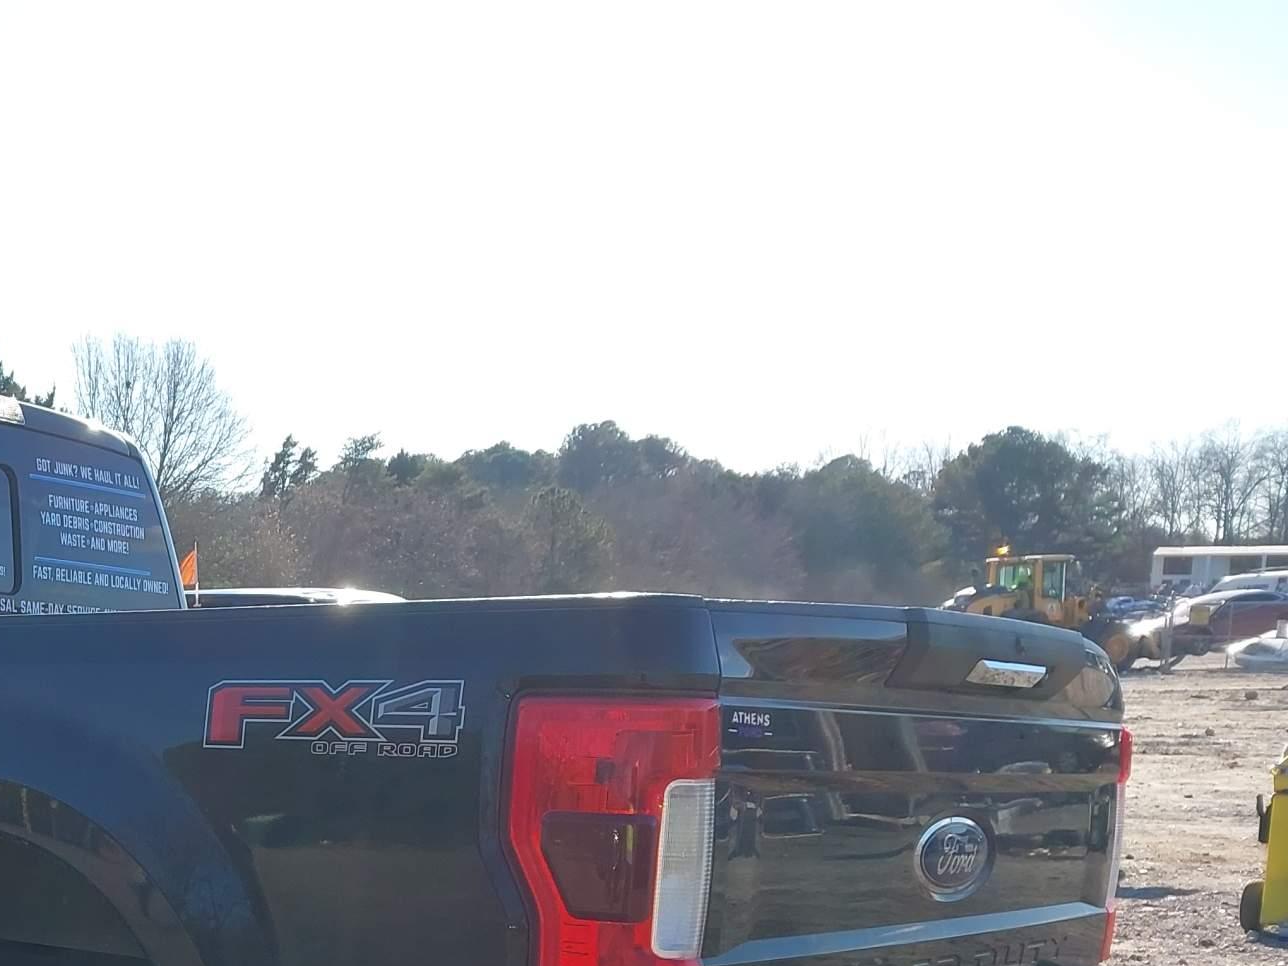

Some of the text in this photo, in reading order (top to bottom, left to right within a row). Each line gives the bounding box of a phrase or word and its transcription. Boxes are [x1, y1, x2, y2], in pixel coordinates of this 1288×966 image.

[36, 458, 140, 490] GOT JUNK? WE HAUL IT ALL!
[40, 511, 62, 527] YARD
[107, 540, 129, 554] MORE!
[32, 564, 169, 594] FAST, RELIABLE AND LOCALLY OWNED!
[203, 680, 464, 749] FX4
[732, 711, 770, 726] ATHENS
[311, 741, 458, 758] OFF ROAD
[937, 833, 979, 876] Ford
